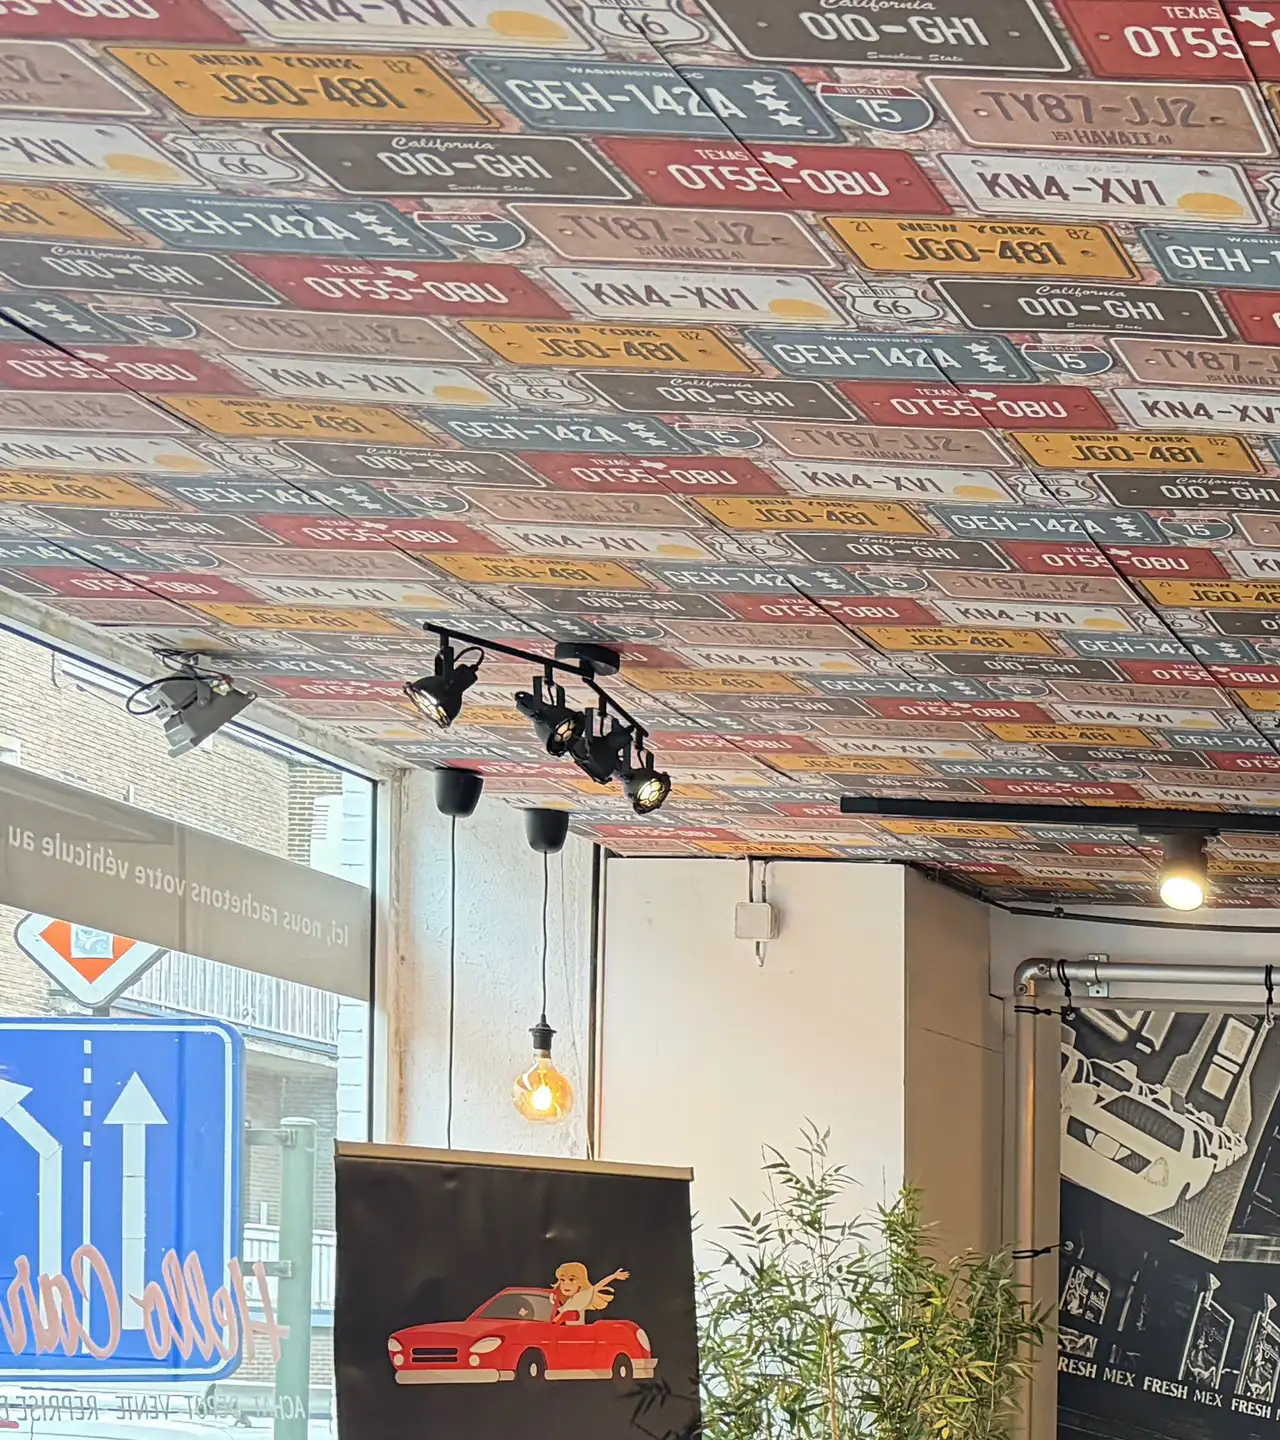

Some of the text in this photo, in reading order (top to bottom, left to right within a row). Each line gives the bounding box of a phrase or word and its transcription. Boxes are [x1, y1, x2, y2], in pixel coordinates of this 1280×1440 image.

[1160, 2, 1222, 19] TEXAS
[188, 52, 270, 66] NEW
[271, 55, 366, 69] YORK
[380, 60, 422, 74] 82
[503, 79, 751, 119] GEH-142A
[855, 98, 907, 124] 15
[691, 148, 751, 161] TEXAS
[819, 679, 950, 693] GEH-142A
[1058, 1357, 1097, 1379] RESH
[1103, 1367, 1135, 1387] MEX
[1143, 1377, 1188, 1399] FRESH
[1194, 1389, 1223, 1407] MEX
[1231, 1398, 1271, 1419] FRESH
